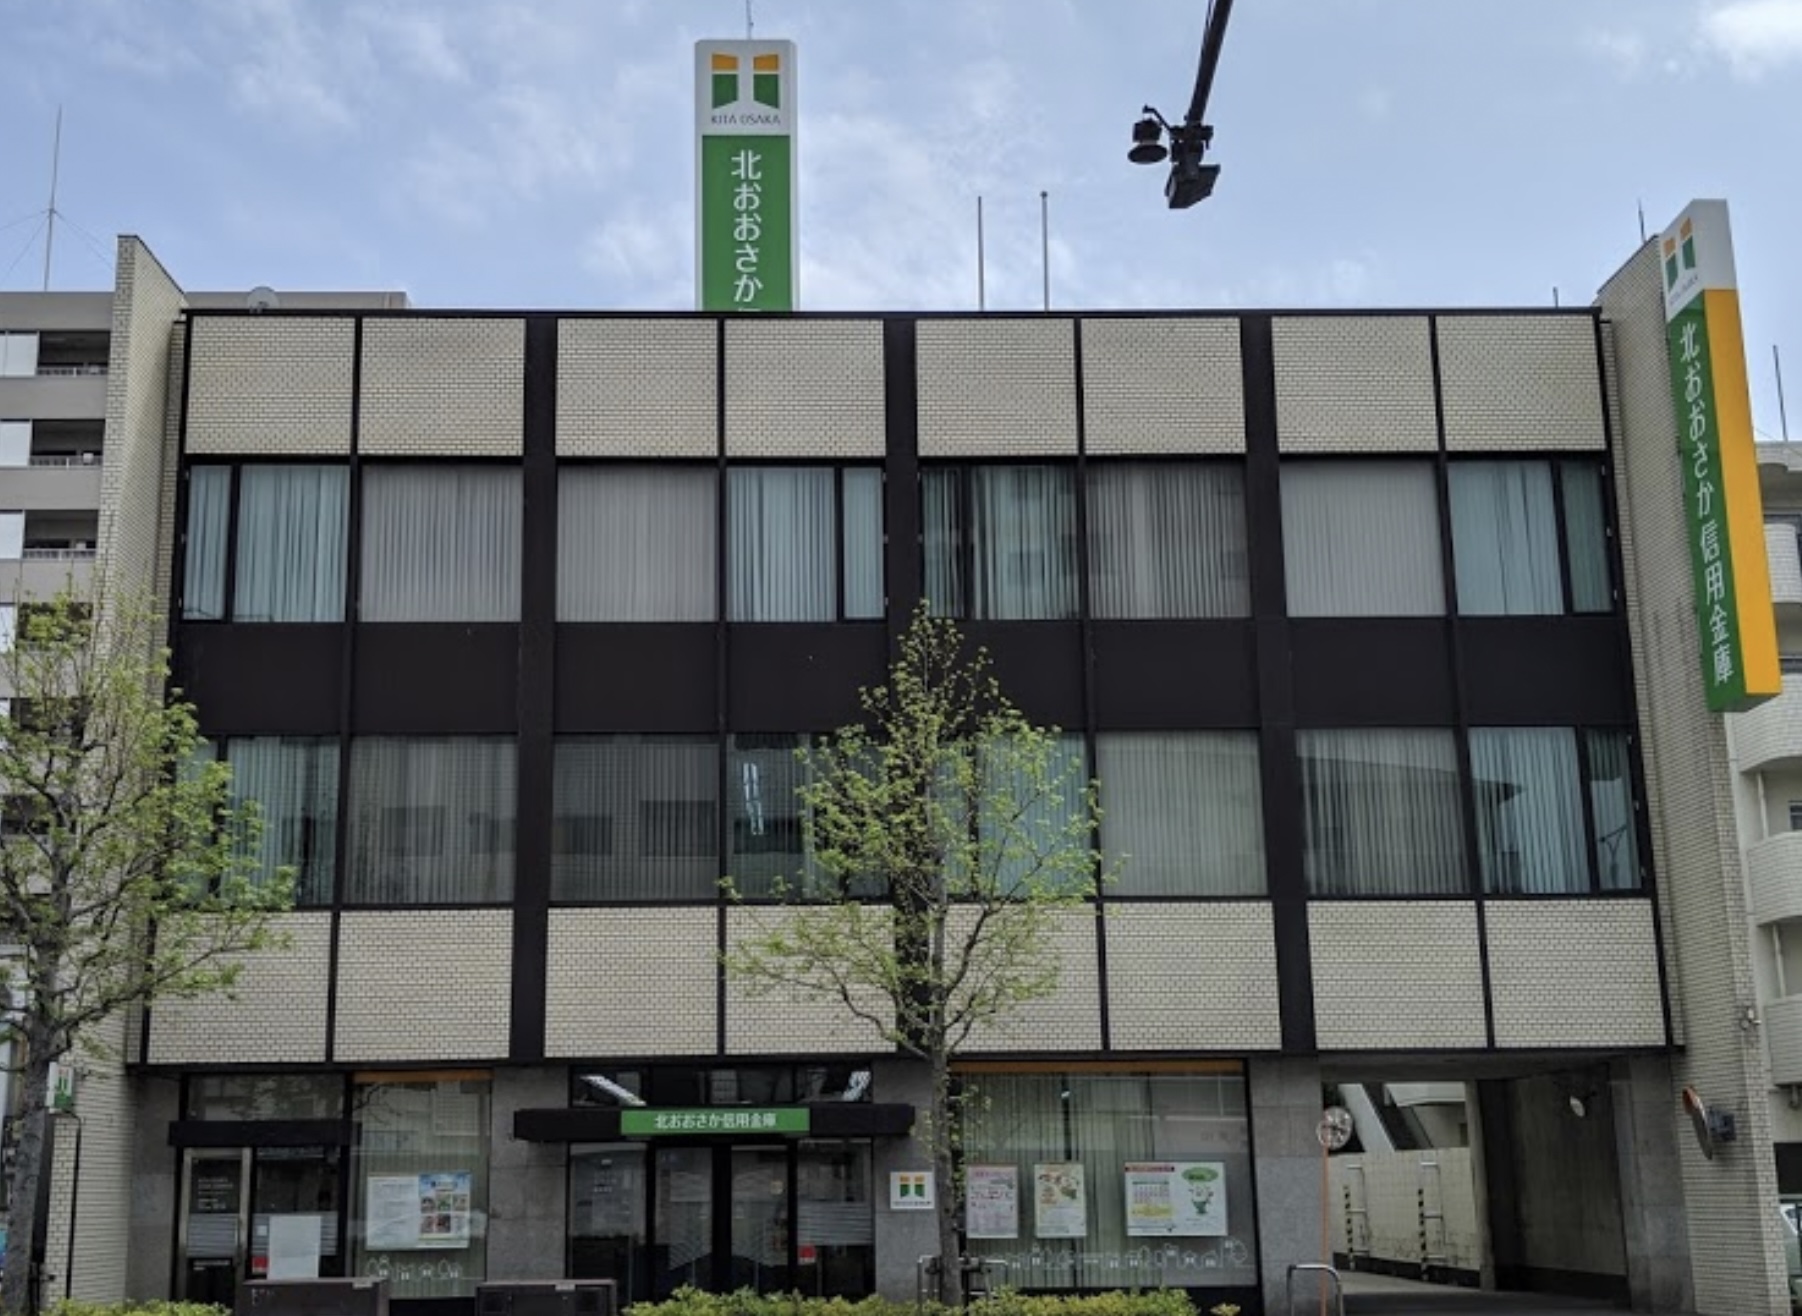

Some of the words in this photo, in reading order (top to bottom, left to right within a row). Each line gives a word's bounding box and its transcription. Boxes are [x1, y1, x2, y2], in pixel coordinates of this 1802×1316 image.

[711, 114, 737, 124] KITA
[740, 113, 781, 125] OSAKA
[731, 149, 763, 312] 北おおさか
[1680, 322, 1734, 687] 北おおさか信用金庫
[655, 1112, 776, 1129] 北おおさか信用金庫
